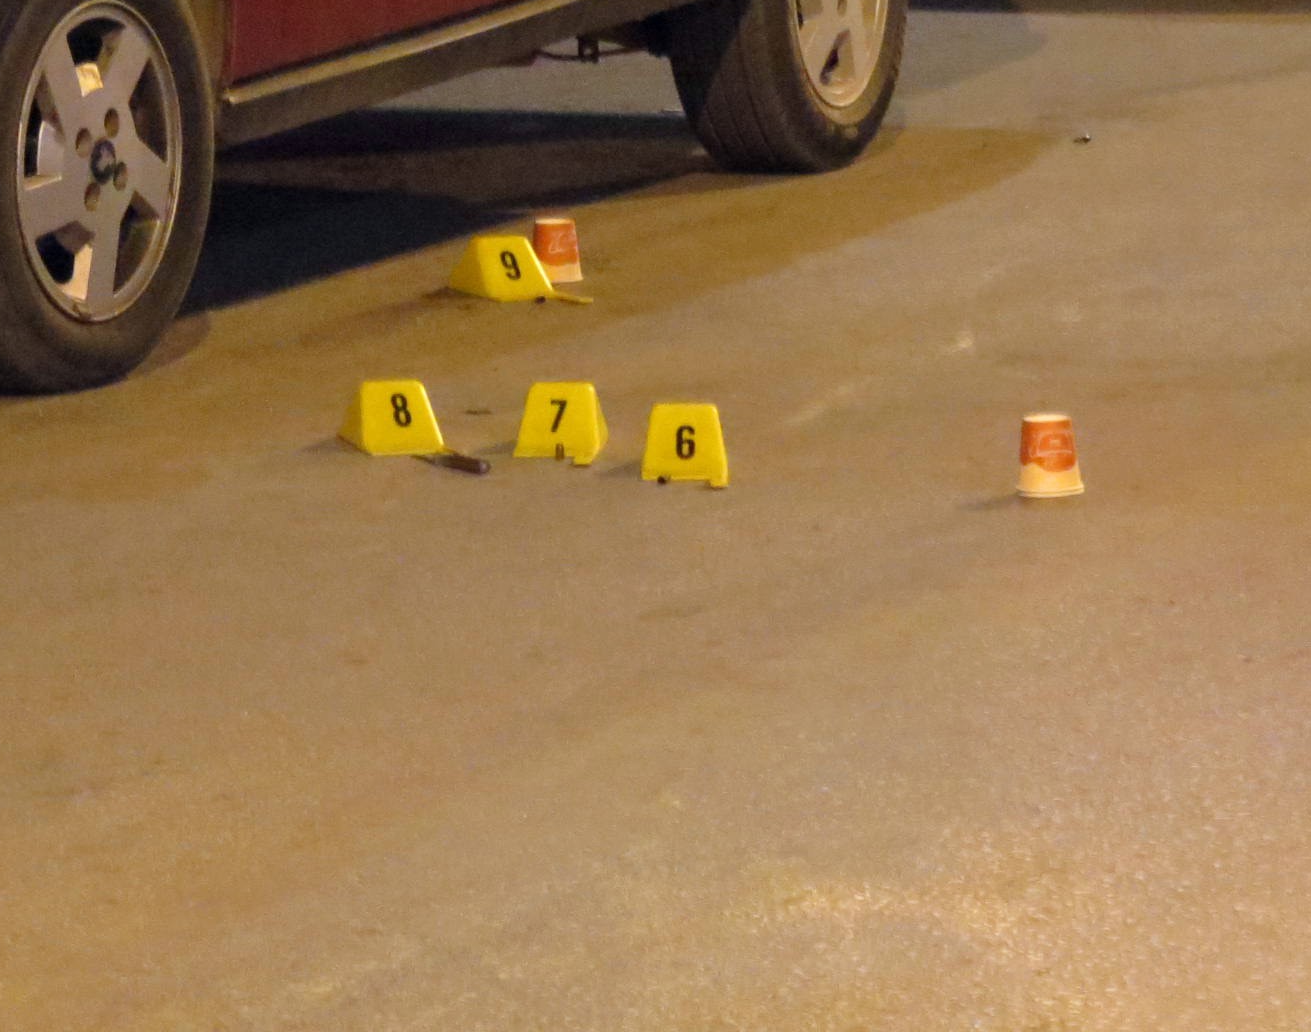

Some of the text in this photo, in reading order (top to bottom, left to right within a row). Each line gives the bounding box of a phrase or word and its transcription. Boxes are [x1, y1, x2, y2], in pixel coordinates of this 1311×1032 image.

[500, 250, 521, 281] 9
[390, 393, 412, 428] 8
[550, 399, 567, 433] 7
[675, 425, 695, 459] 6
